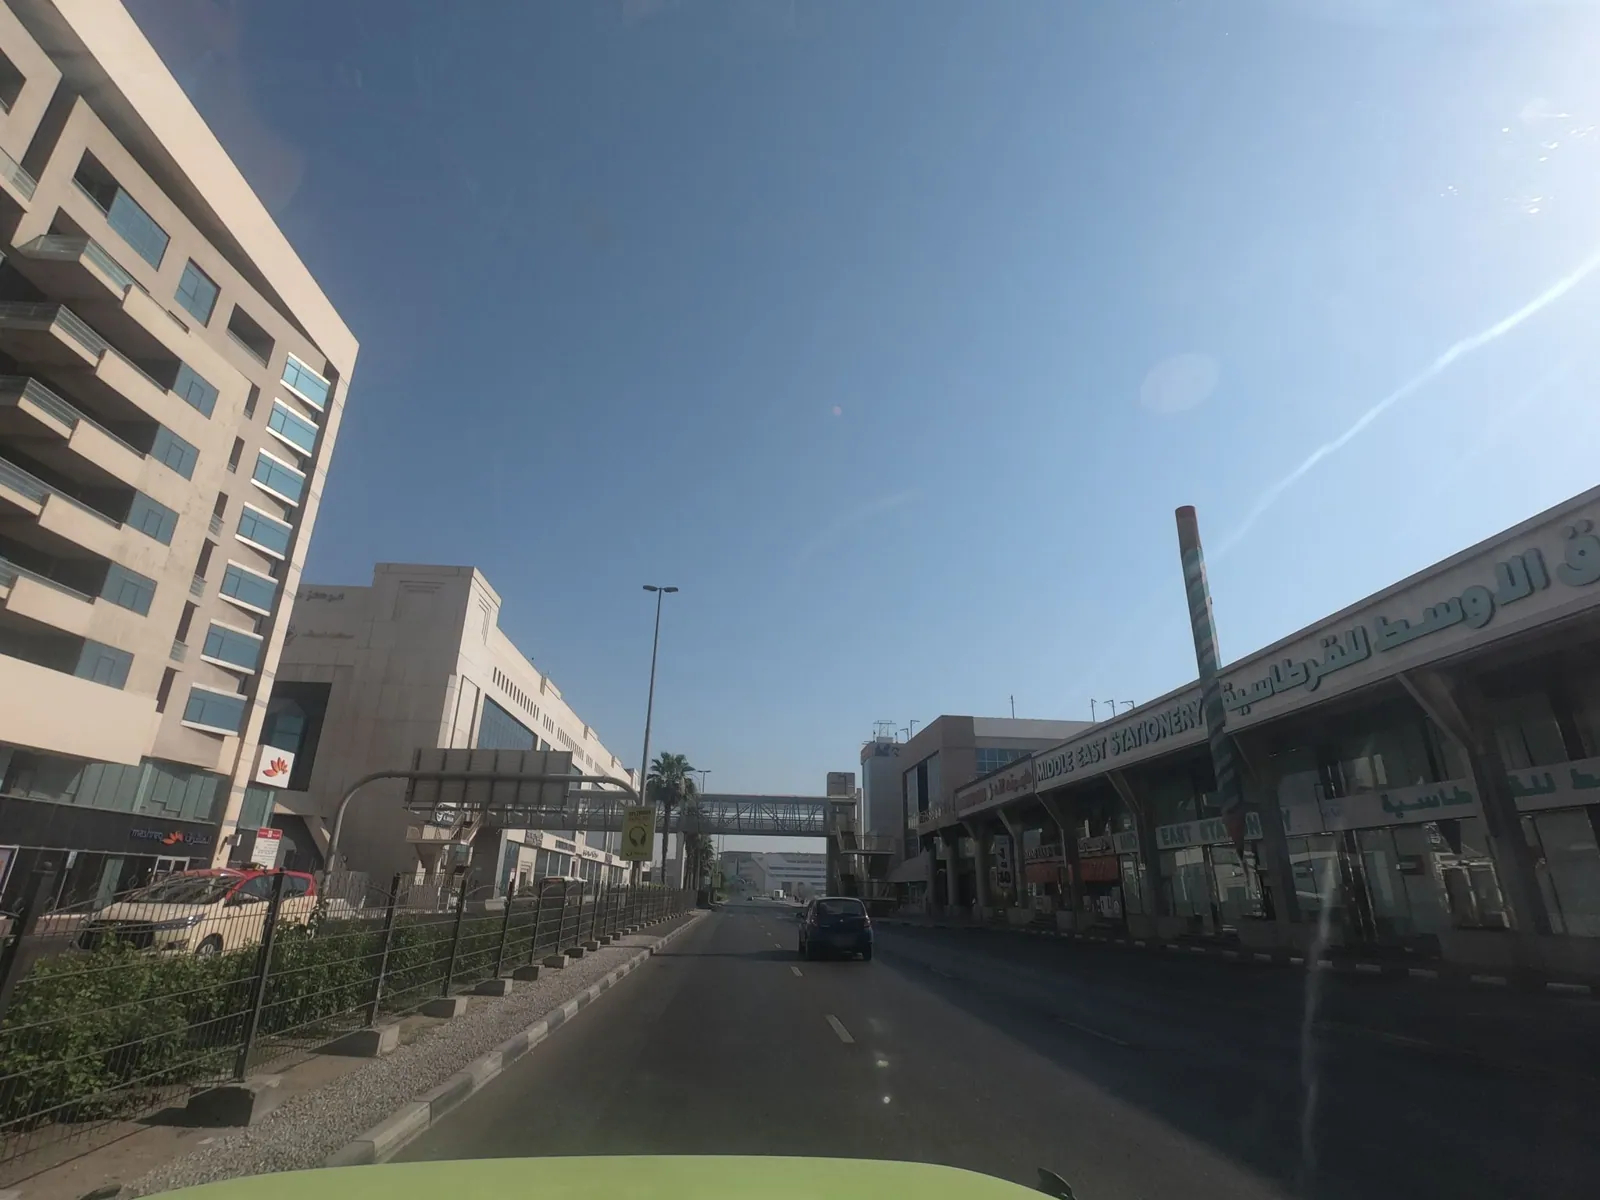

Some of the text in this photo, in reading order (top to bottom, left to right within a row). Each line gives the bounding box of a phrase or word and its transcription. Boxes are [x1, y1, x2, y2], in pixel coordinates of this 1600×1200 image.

[1221, 625, 1371, 716] للقرطاسية
[1037, 698, 1203, 782] MIDDLE EAST STATIONERY
[131, 829, 163, 843] mashreq
[1160, 824, 1192, 846] EAST
